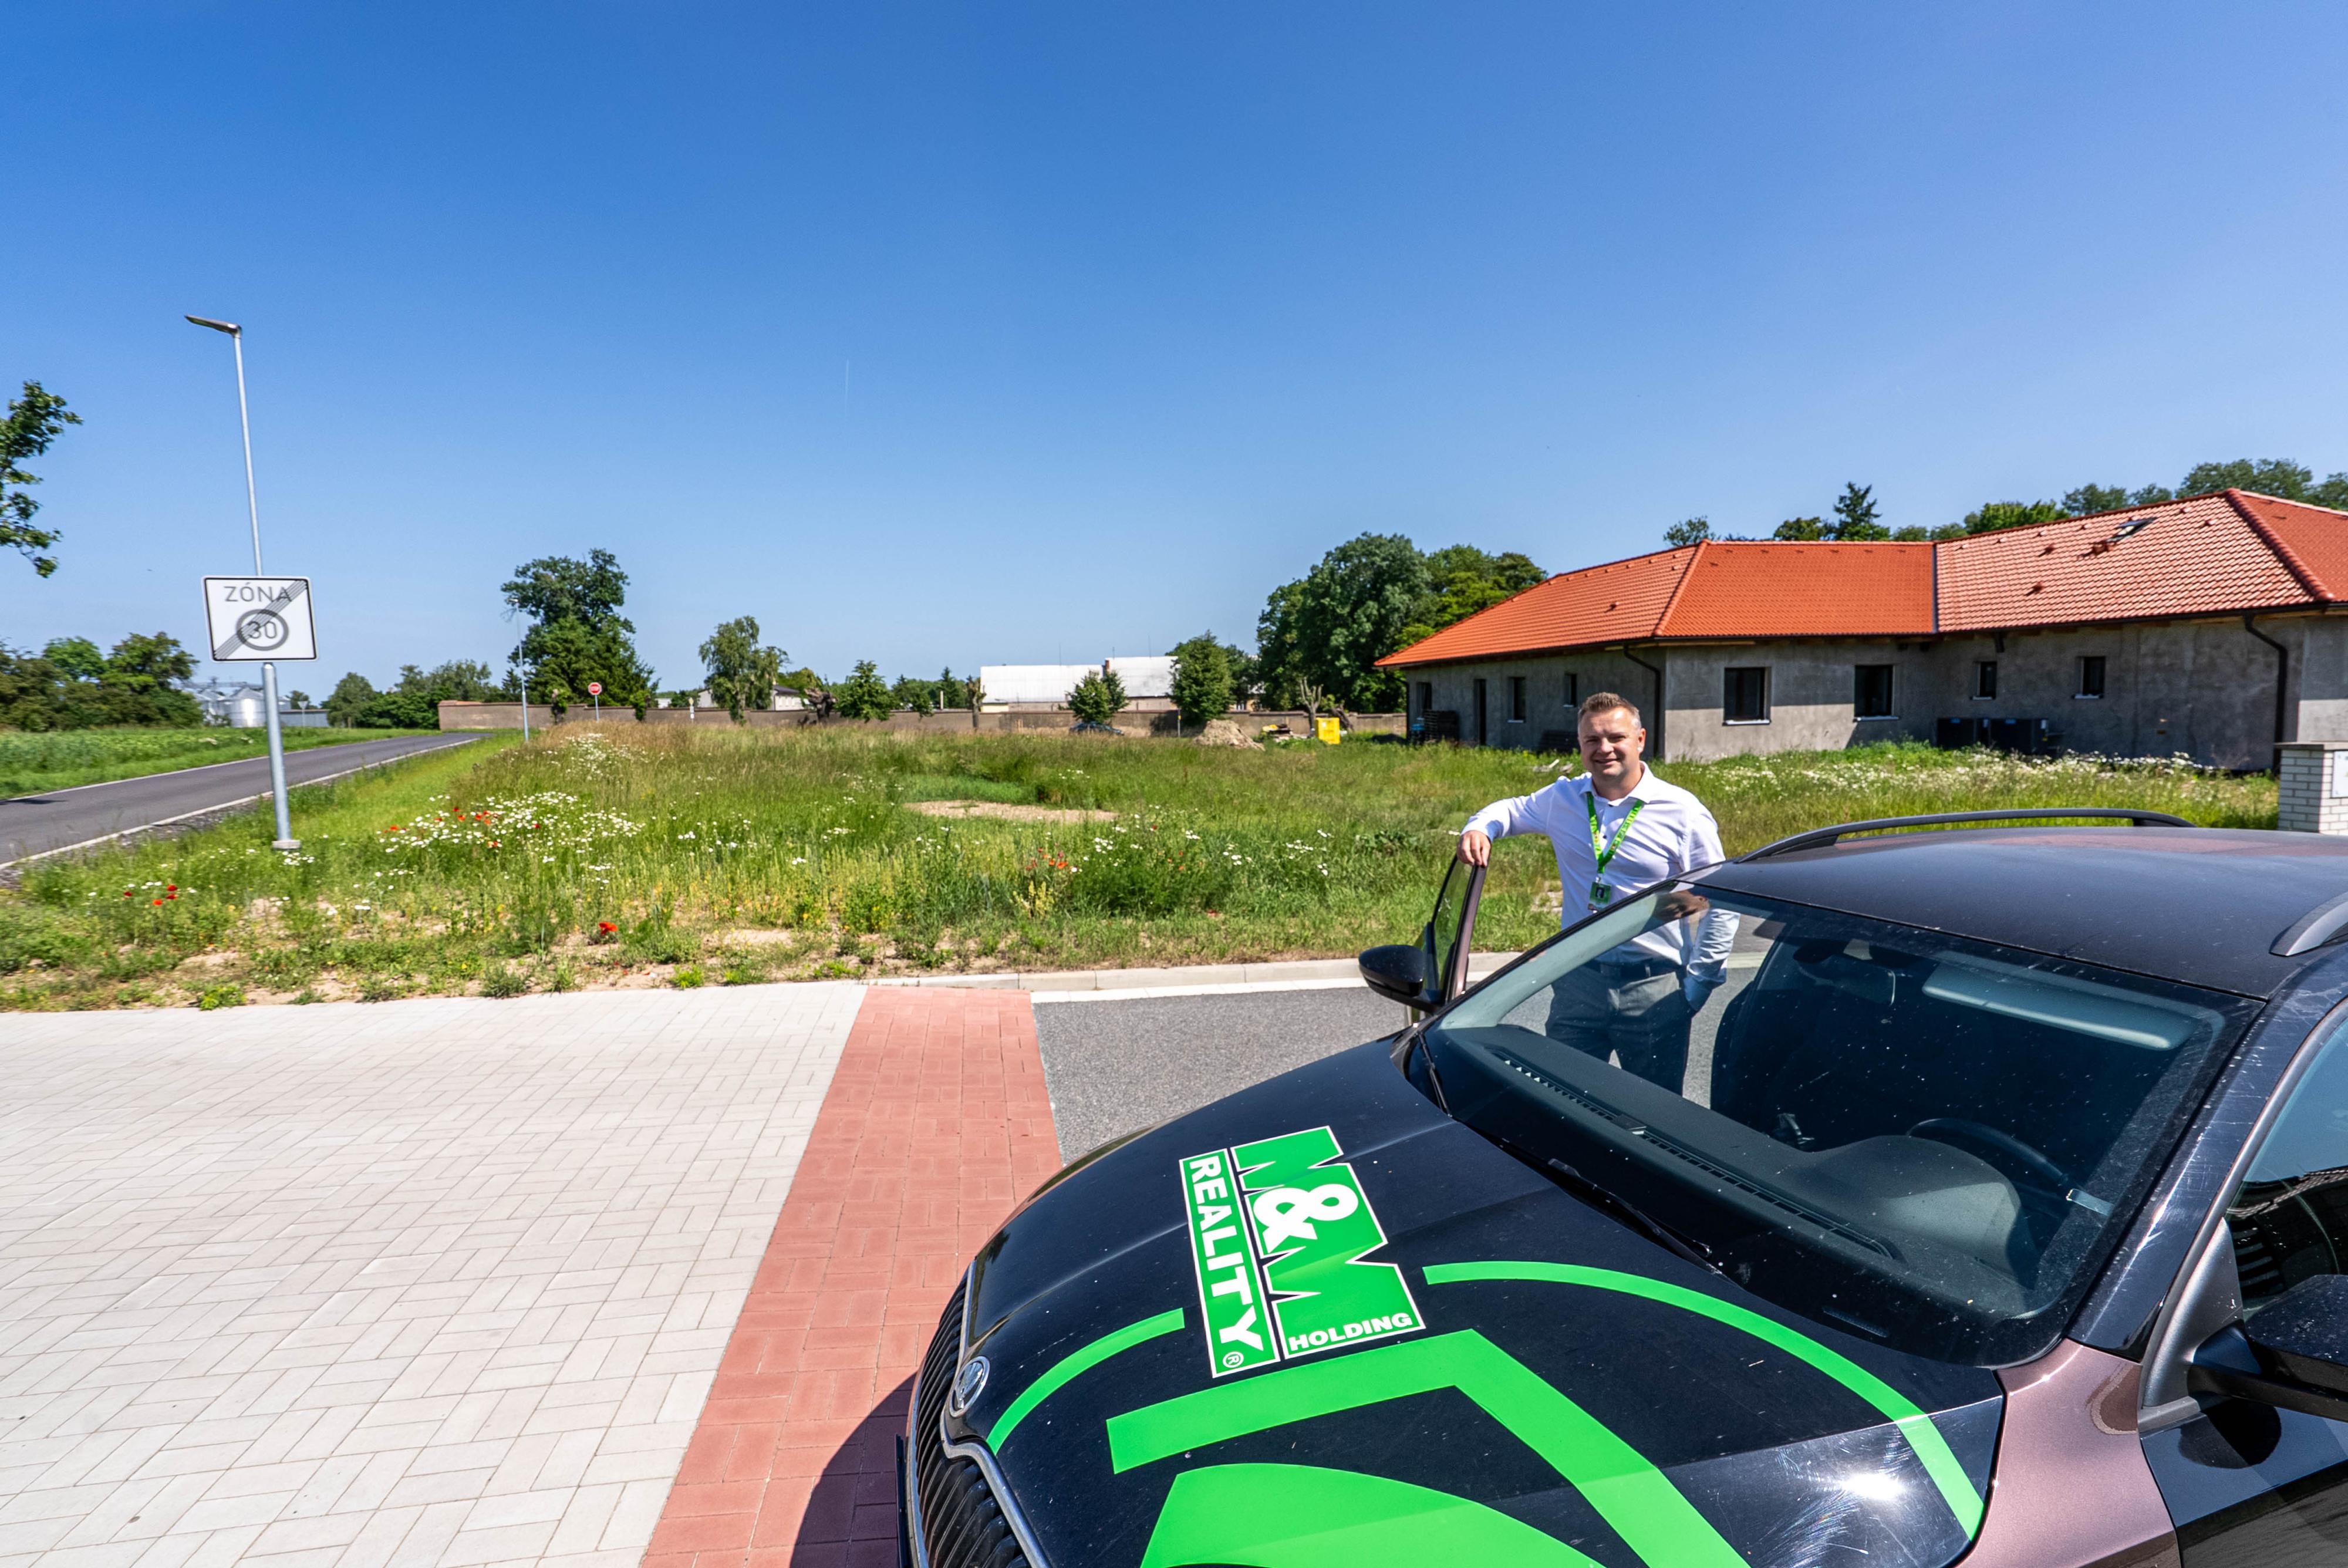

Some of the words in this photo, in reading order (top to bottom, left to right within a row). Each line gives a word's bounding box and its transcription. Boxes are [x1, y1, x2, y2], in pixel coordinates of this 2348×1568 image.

[224, 582, 292, 602] ZÓNA
[247, 621, 278, 639] 30
[1230, 1125, 1426, 1360] M&M
[1288, 1313, 1413, 1351] HOLDING
